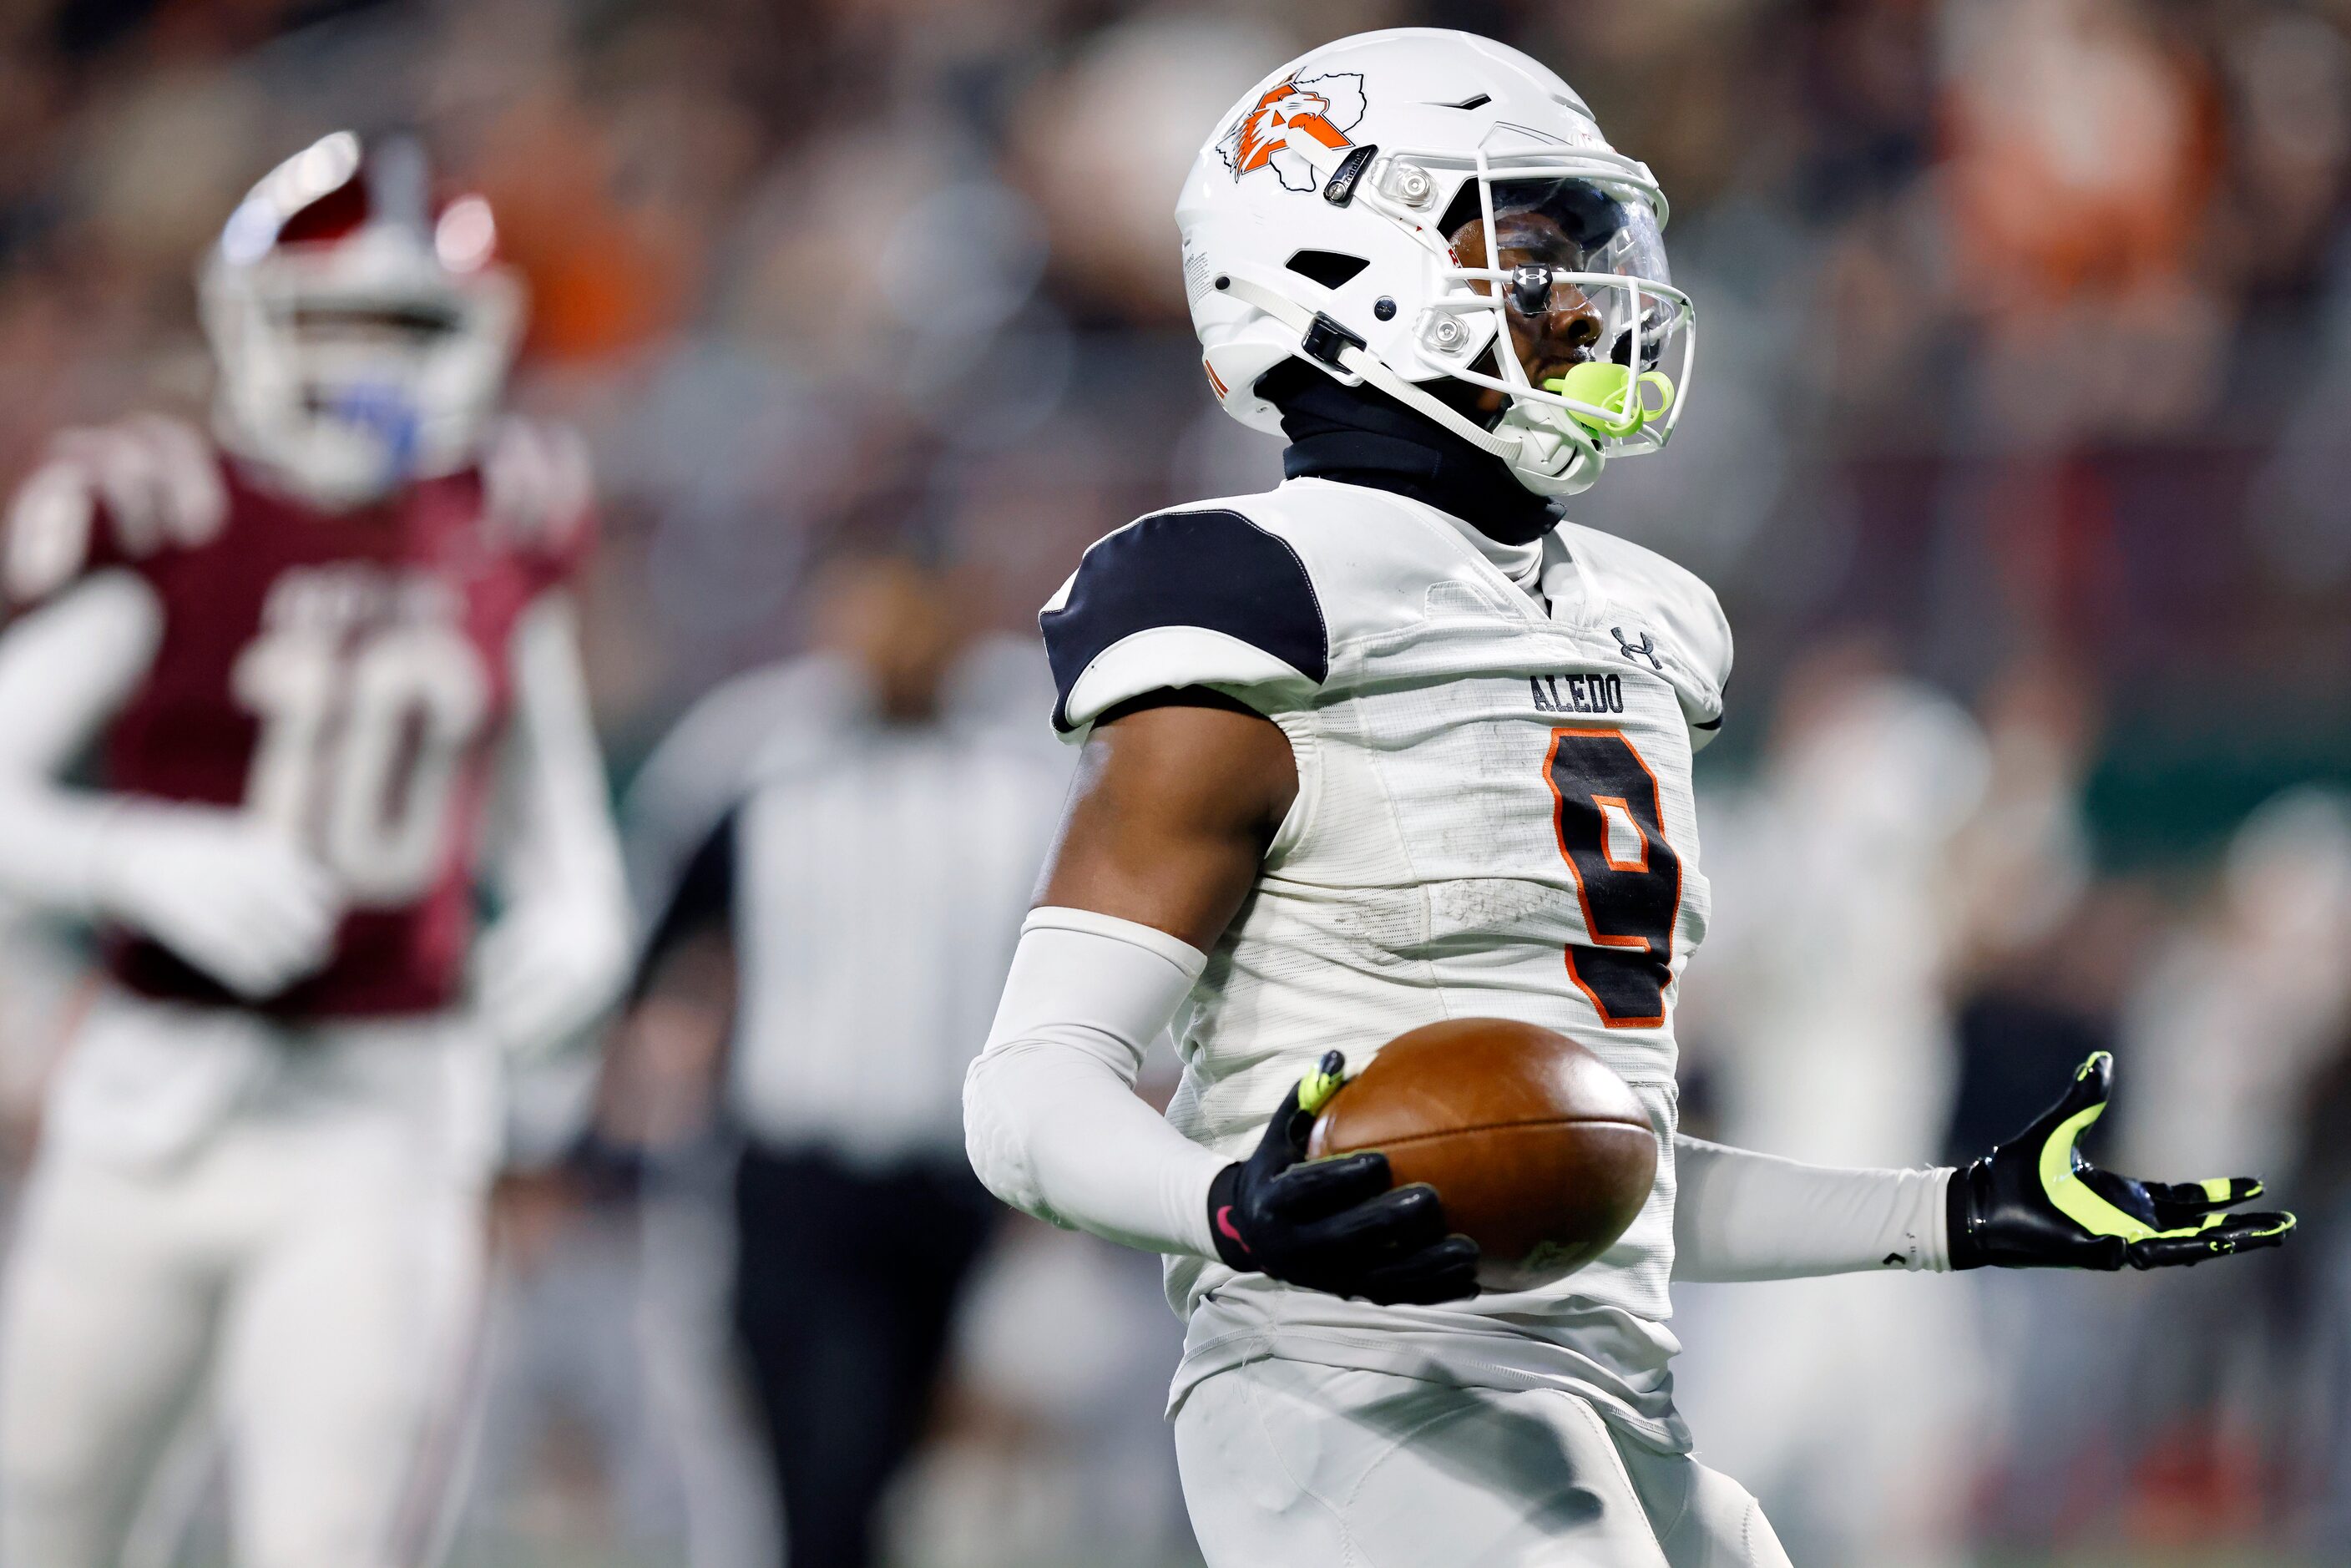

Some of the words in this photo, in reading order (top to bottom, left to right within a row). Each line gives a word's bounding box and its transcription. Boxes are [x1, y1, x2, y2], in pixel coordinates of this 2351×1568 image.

[230, 626, 493, 903] 10
[1529, 674, 1624, 713] ALEDO
[1542, 728, 1681, 1029] 9
